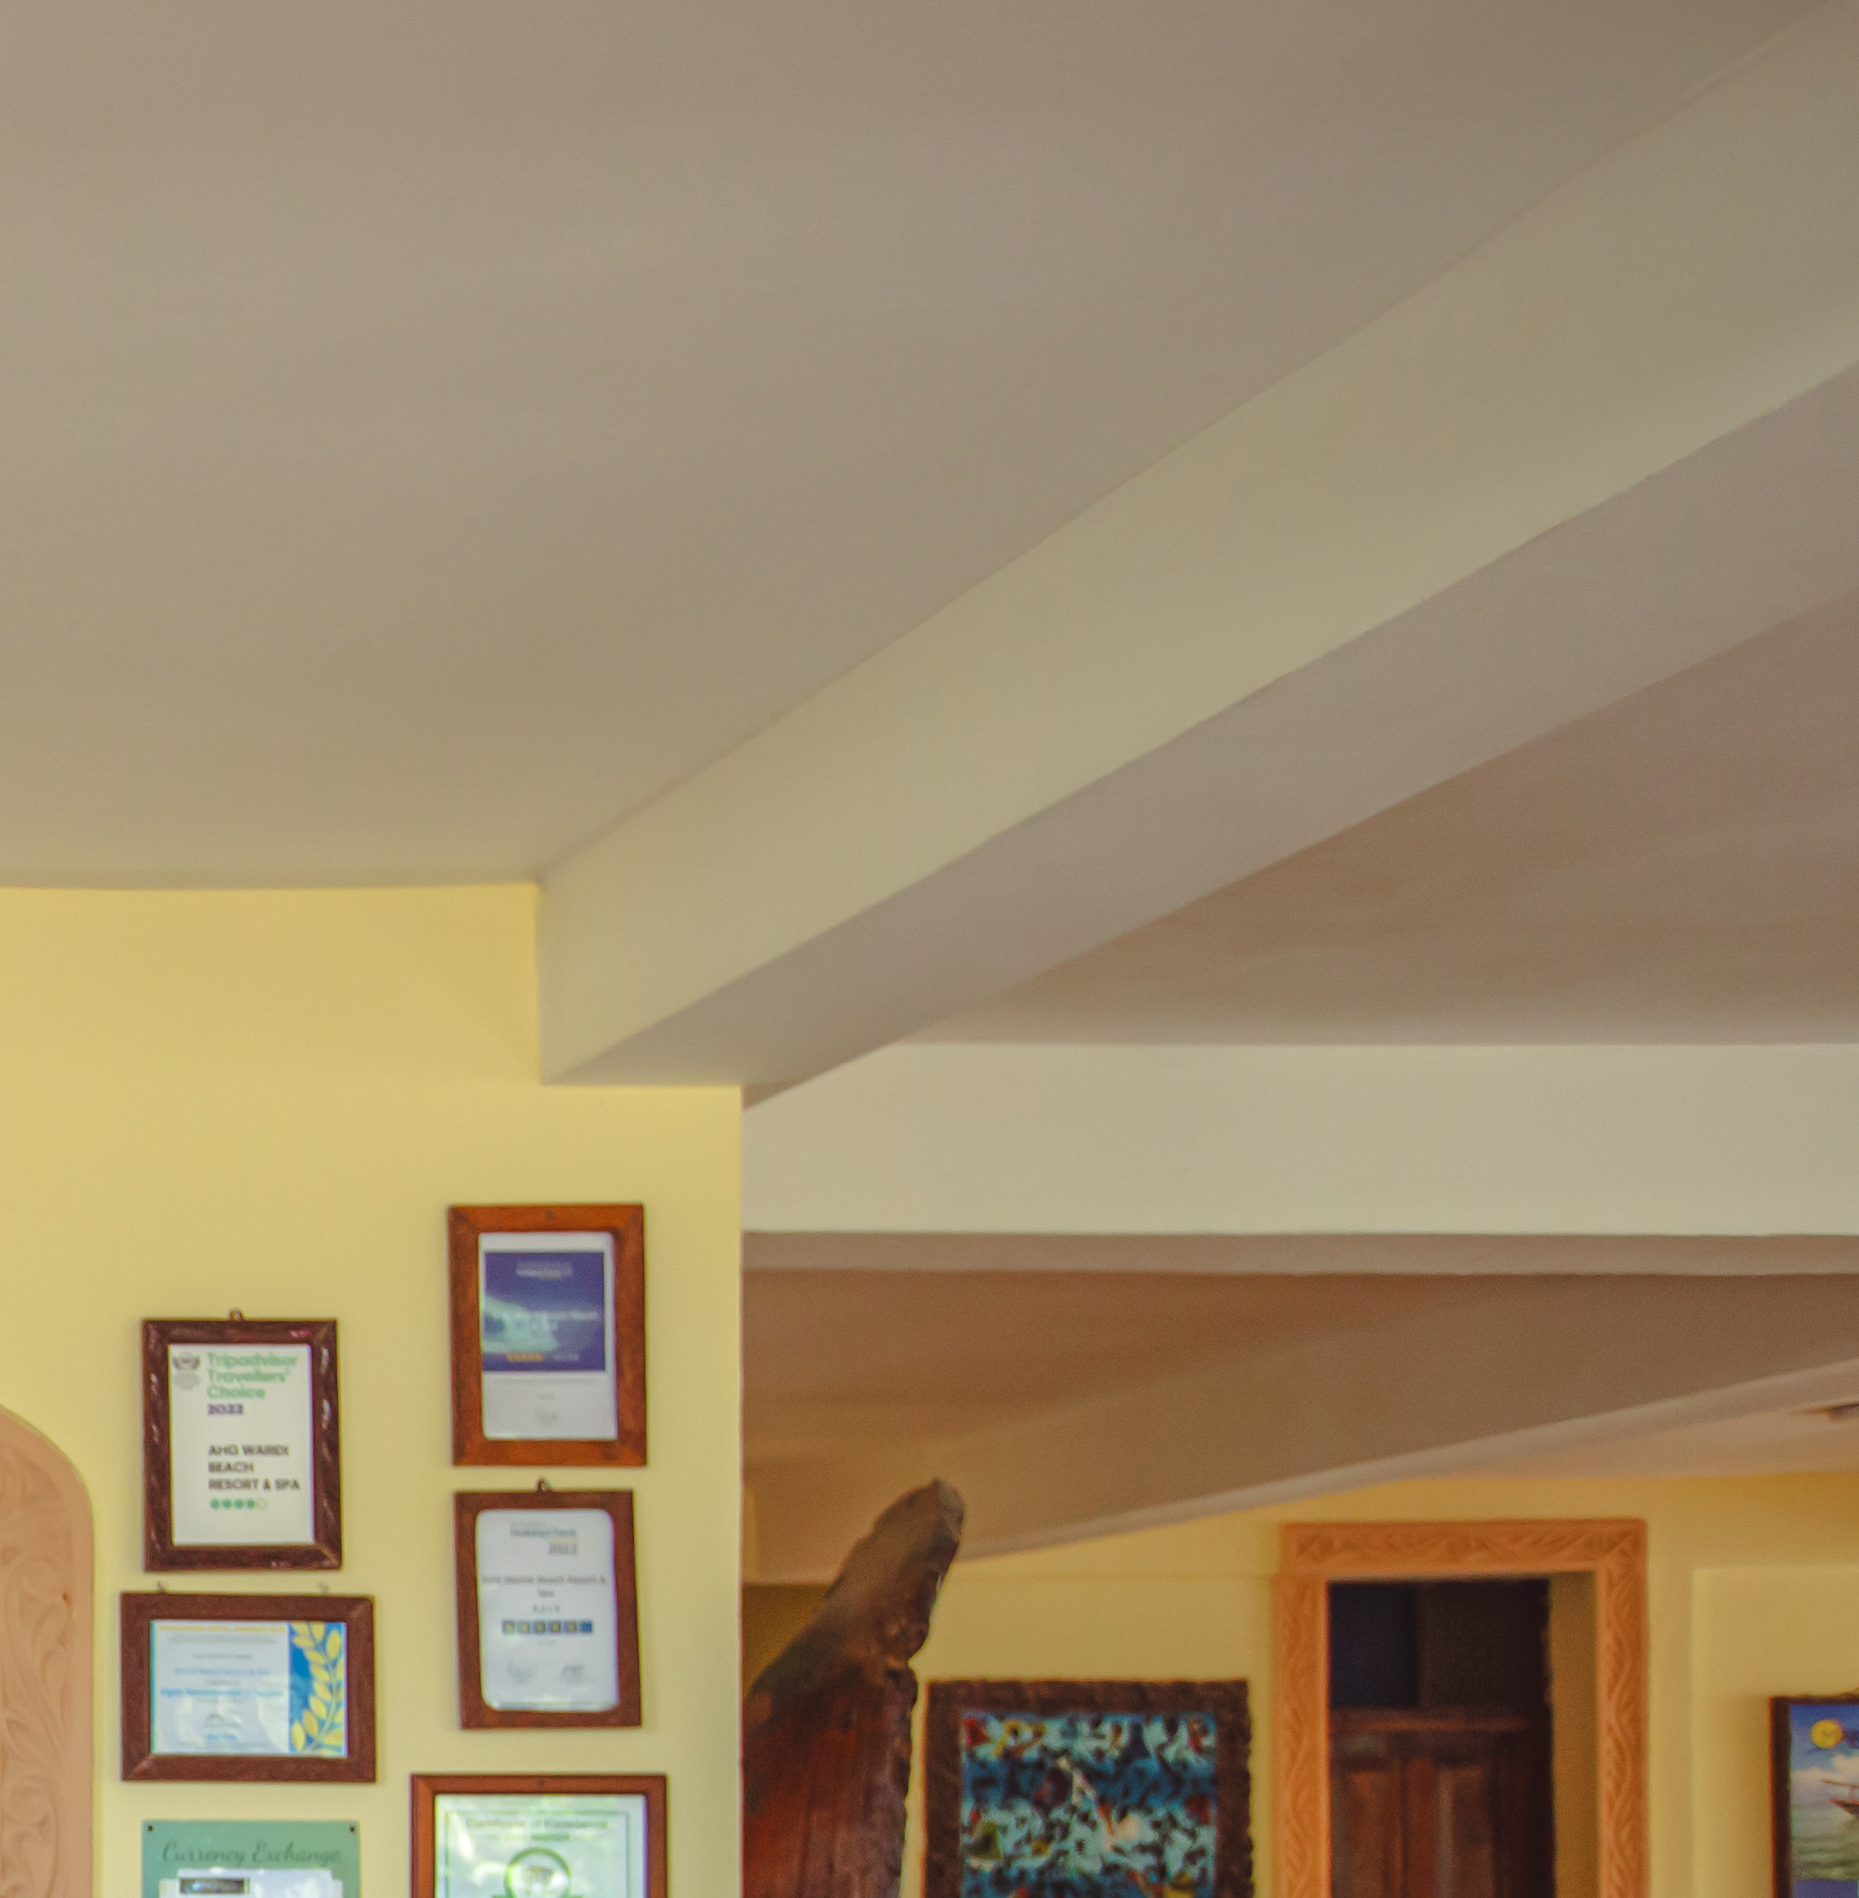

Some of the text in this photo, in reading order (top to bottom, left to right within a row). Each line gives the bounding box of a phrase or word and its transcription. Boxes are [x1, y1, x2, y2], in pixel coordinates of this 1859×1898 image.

[207, 1384, 266, 1399] Choice
[242, 1445, 290, 1456] WARIDI
[208, 1462, 254, 1472] BEACH
[208, 1479, 258, 1490] RESORT
[275, 1479, 301, 1490] SPA
[162, 1840, 340, 1867] Currency Exchange
